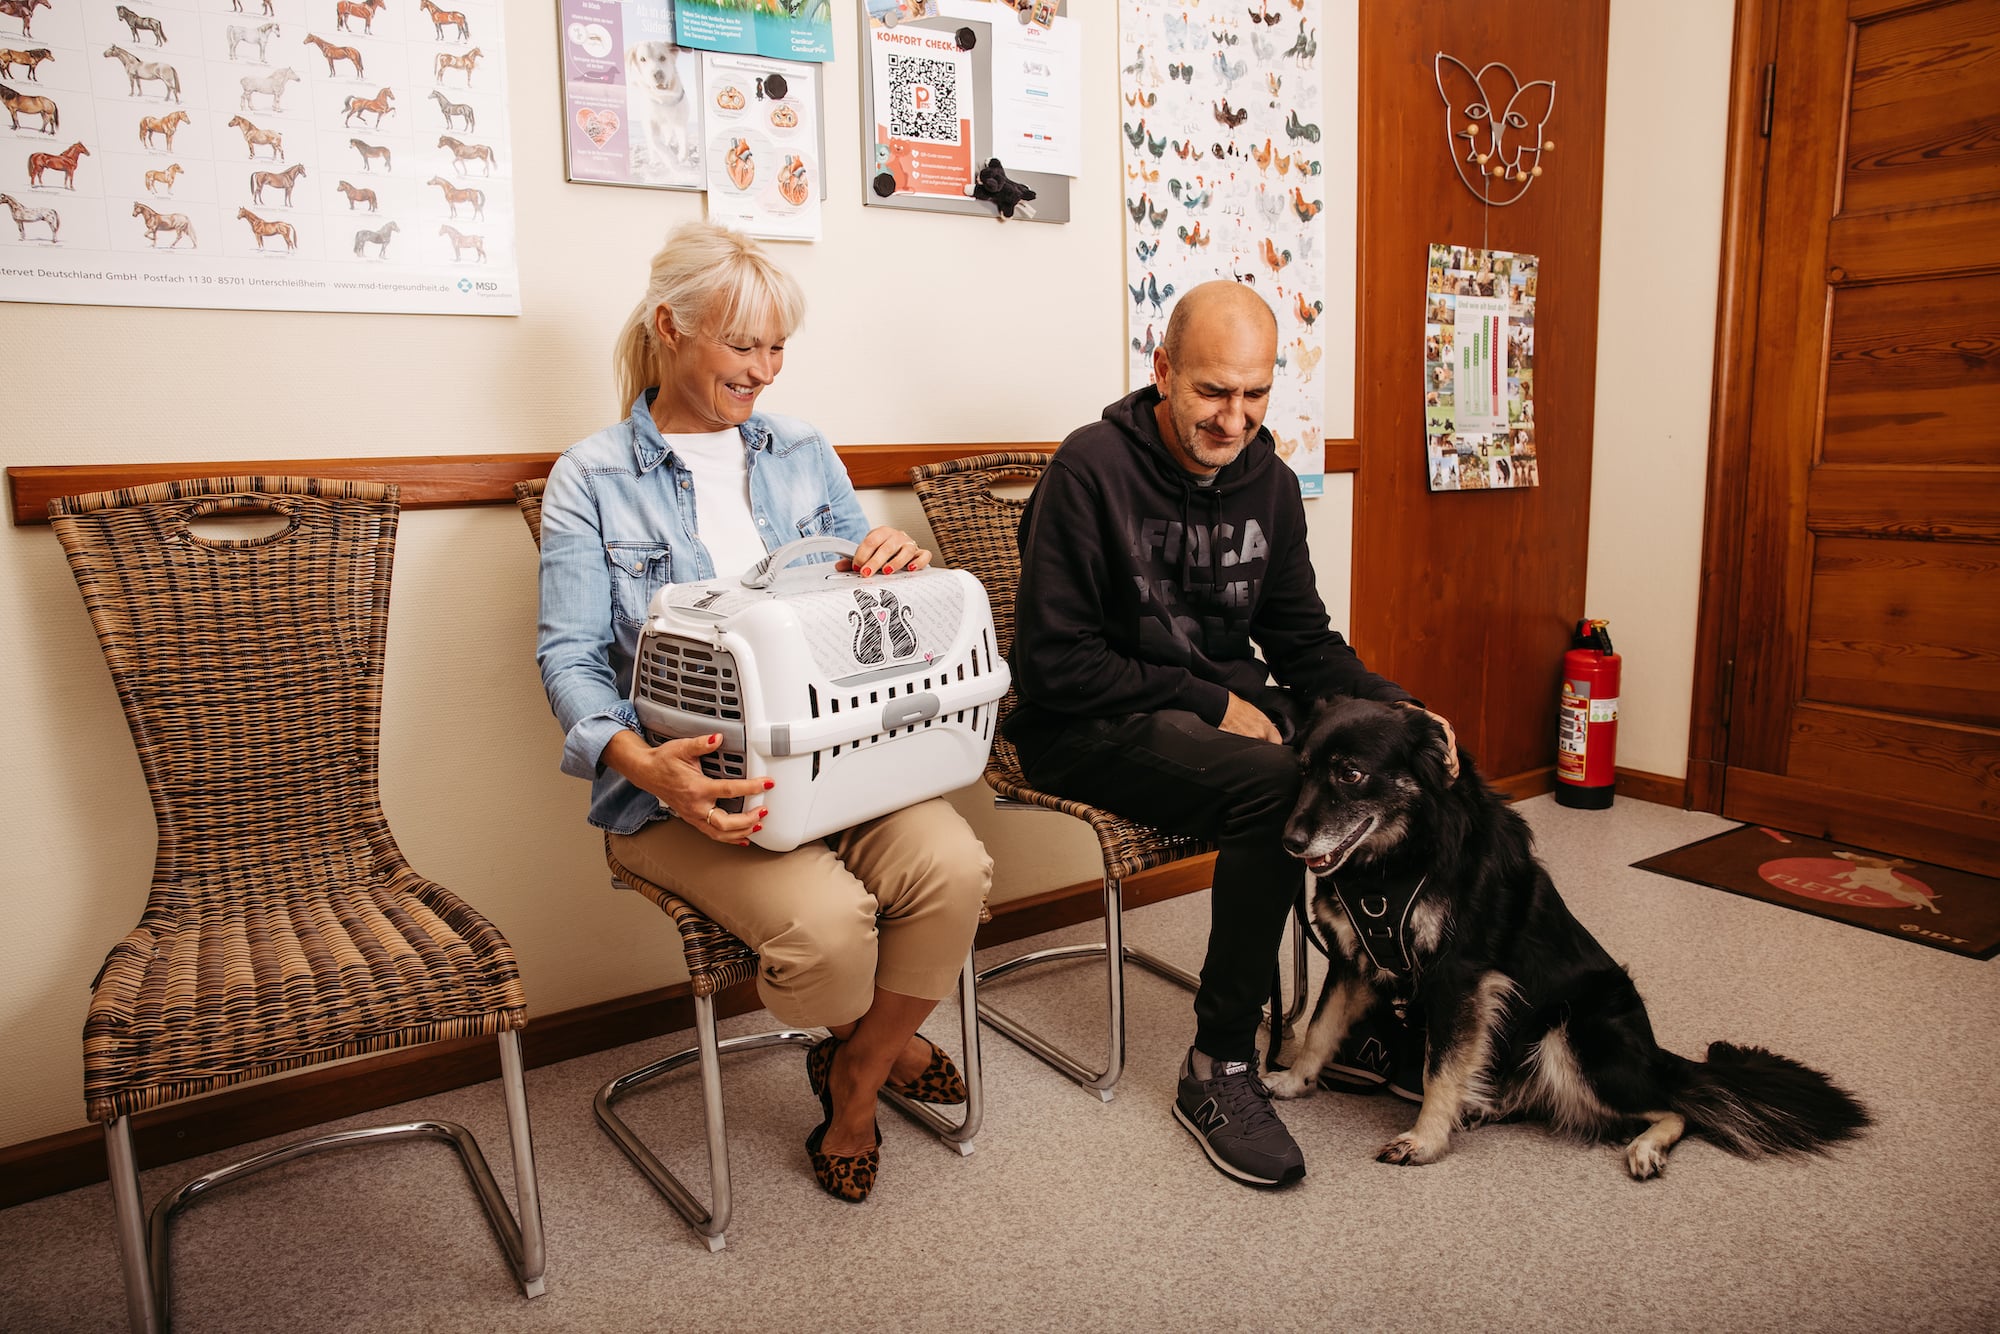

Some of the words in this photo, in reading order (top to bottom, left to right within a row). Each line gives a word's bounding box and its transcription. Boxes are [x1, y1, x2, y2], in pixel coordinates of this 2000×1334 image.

[876, 31, 922, 47] KOMFORT
[0, 267, 34, 277] tervet
[37, 268, 103, 280] Deutschland
[105, 272, 138, 281] GmbH
[143, 273, 185, 284] Postfach
[217, 276, 246, 285] 85701
[247, 277, 326, 289] Unterschleißheim
[333, 279, 450, 293] www.msd-tiergesundheit.de
[475, 281, 498, 291] MSD
